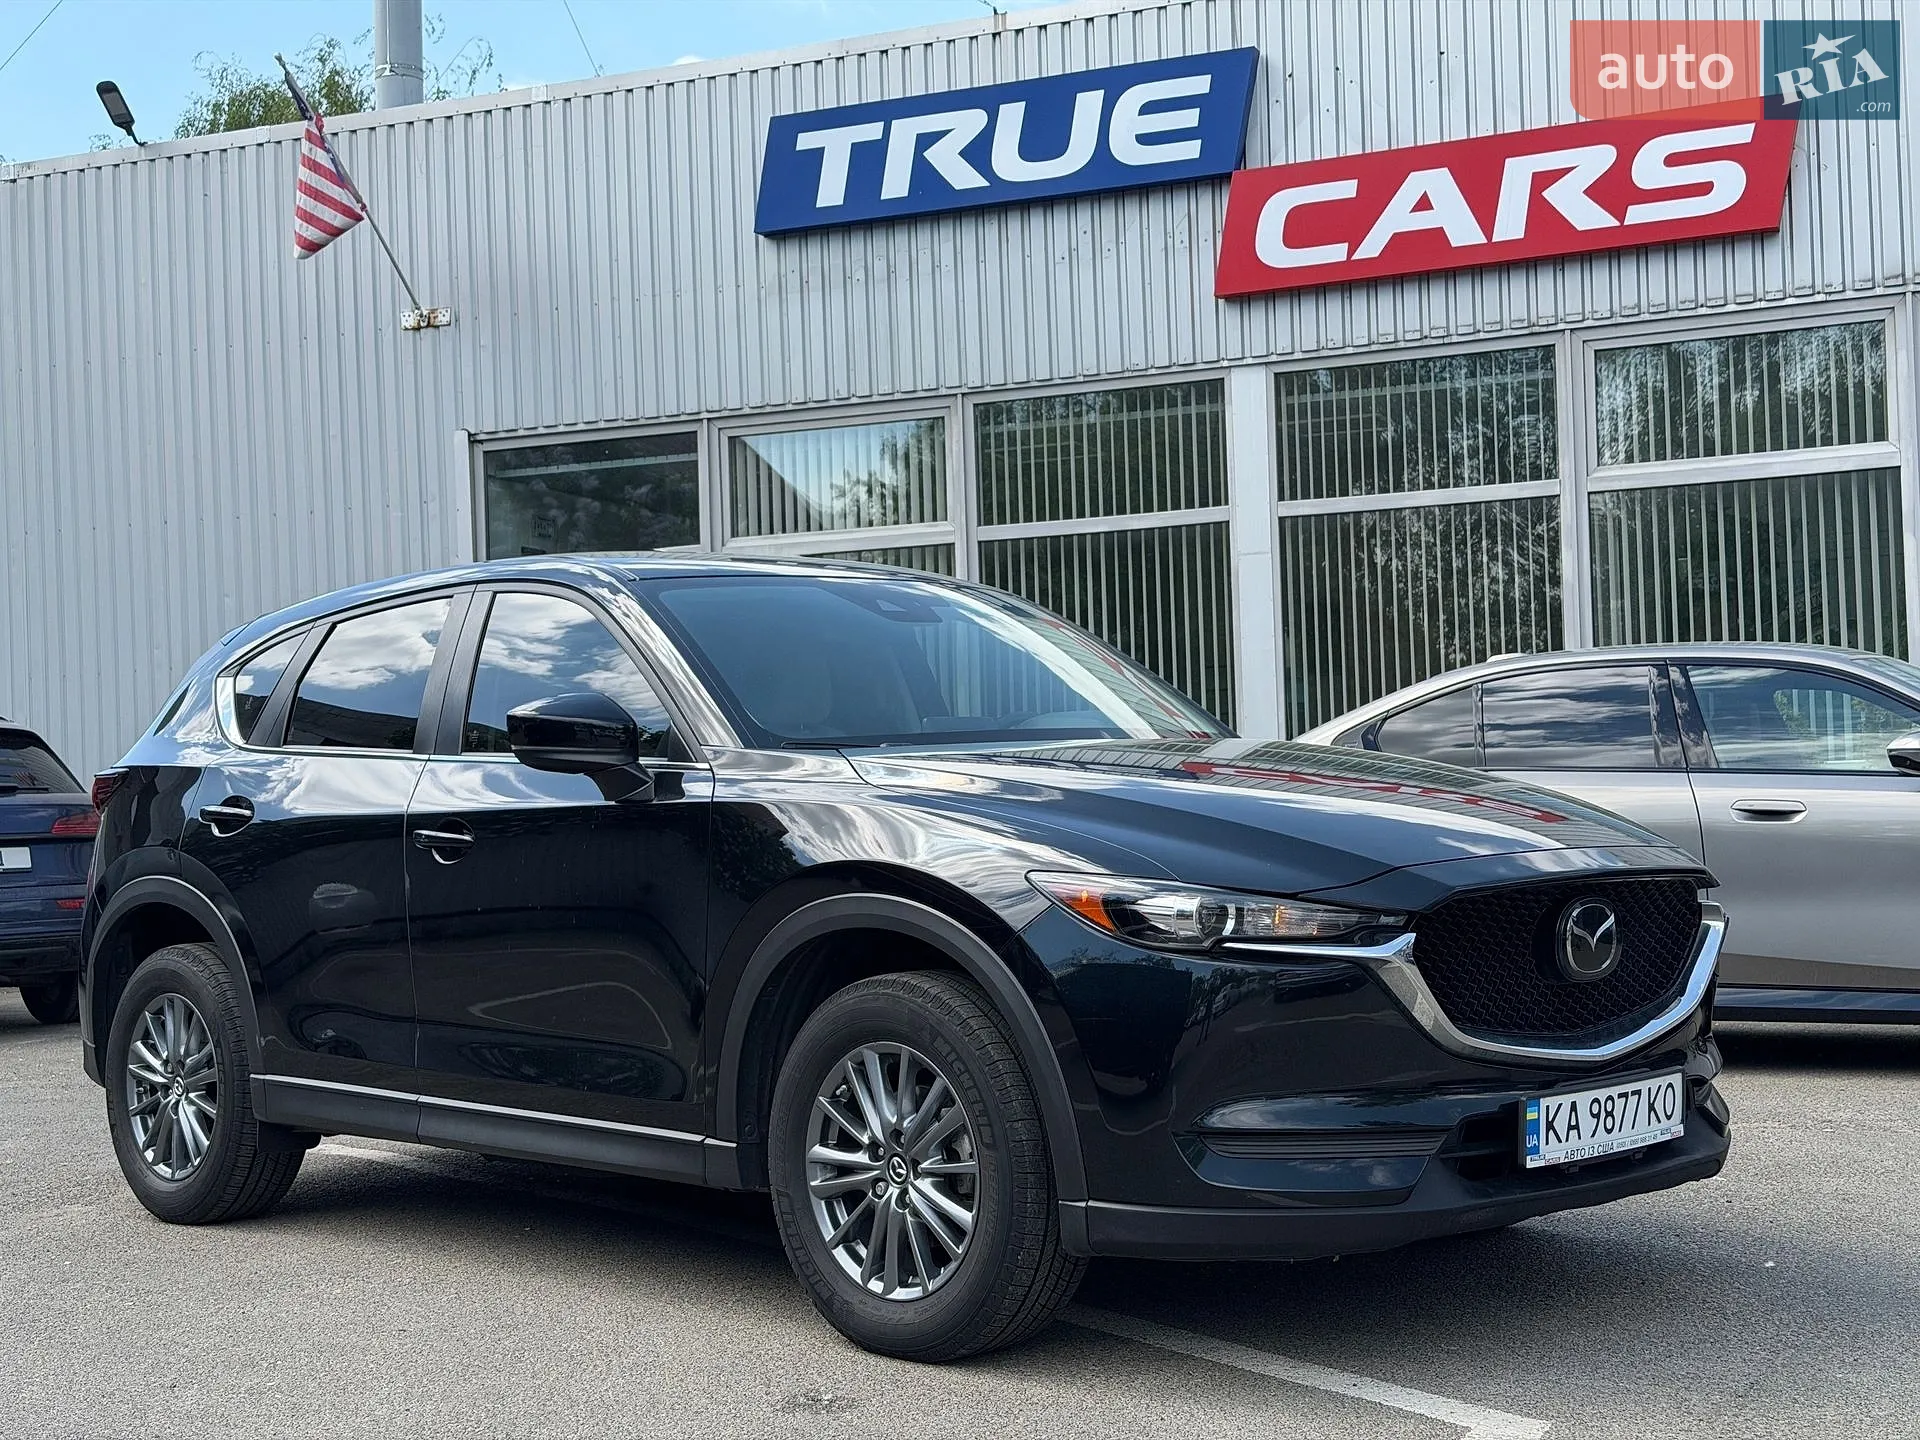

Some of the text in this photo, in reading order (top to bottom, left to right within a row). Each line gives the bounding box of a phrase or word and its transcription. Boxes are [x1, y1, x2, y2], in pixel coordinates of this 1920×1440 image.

[796, 74, 1211, 208] TRUE
[1254, 122, 1756, 269] CARS
[1526, 1133, 1539, 1147] UA
[1545, 1082, 1676, 1146] KA 9877 KO
[1563, 1147, 1586, 1161] АВТО
[1597, 1142, 1614, 1155] США
